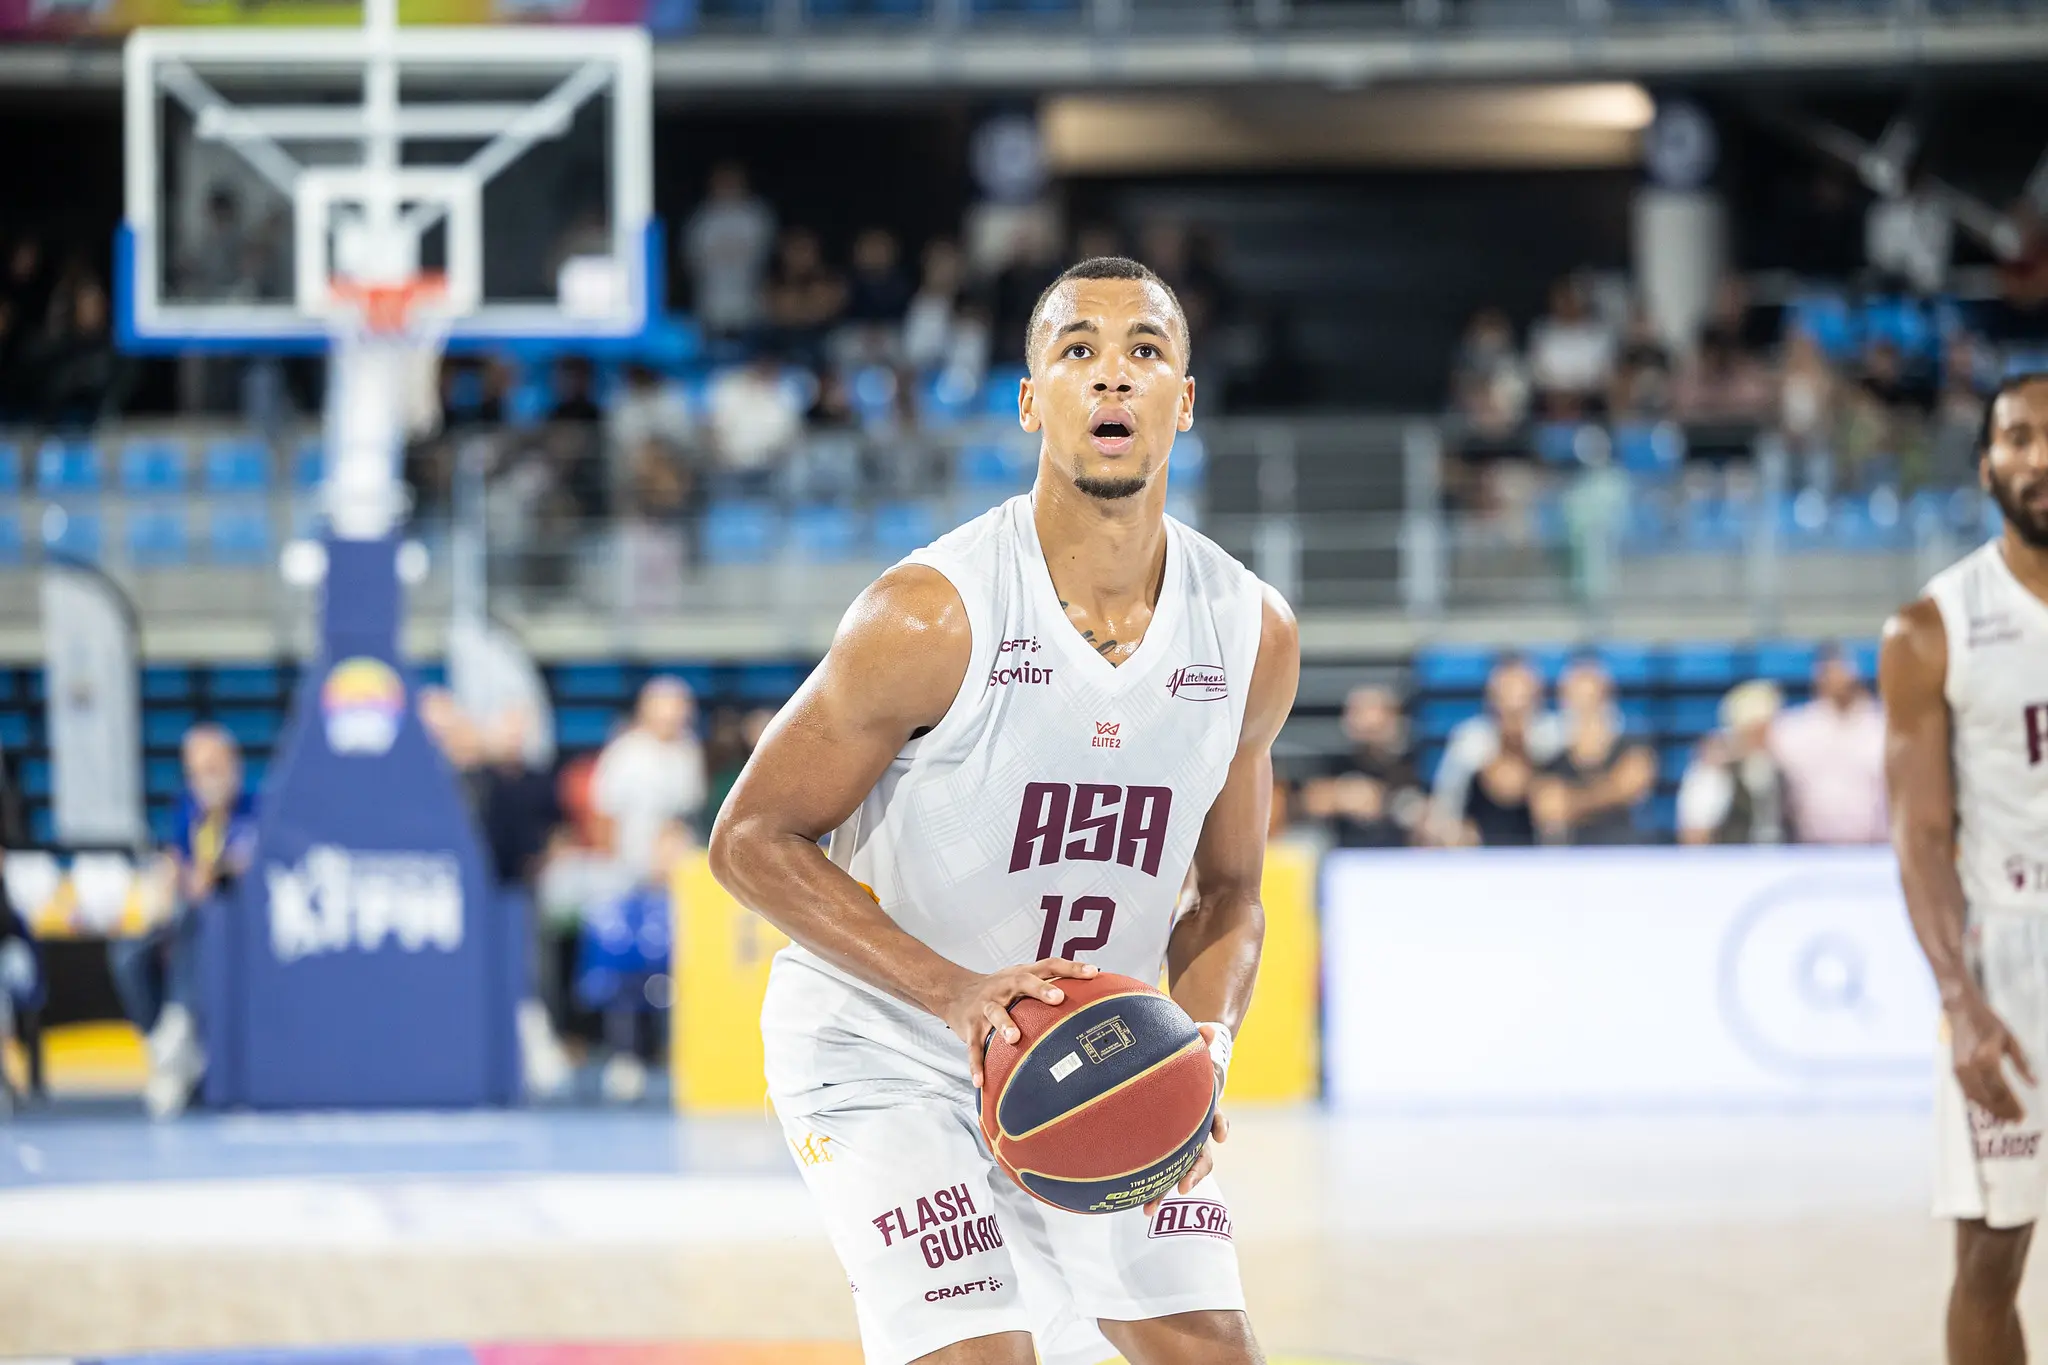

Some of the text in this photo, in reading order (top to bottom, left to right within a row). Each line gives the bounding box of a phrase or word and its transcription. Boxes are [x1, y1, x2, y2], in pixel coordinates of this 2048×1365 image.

[1008, 782, 1173, 878] ASA
[1035, 895, 1117, 964] 12
[1129, 1178, 1146, 1189] BALL
[1147, 1171, 1164, 1183] GAME
[872, 1182, 977, 1247] FLASH
[1155, 1205, 1233, 1234] ALSA
[919, 1213, 1005, 1269] GUARD
[924, 1280, 987, 1302] CRAFT
